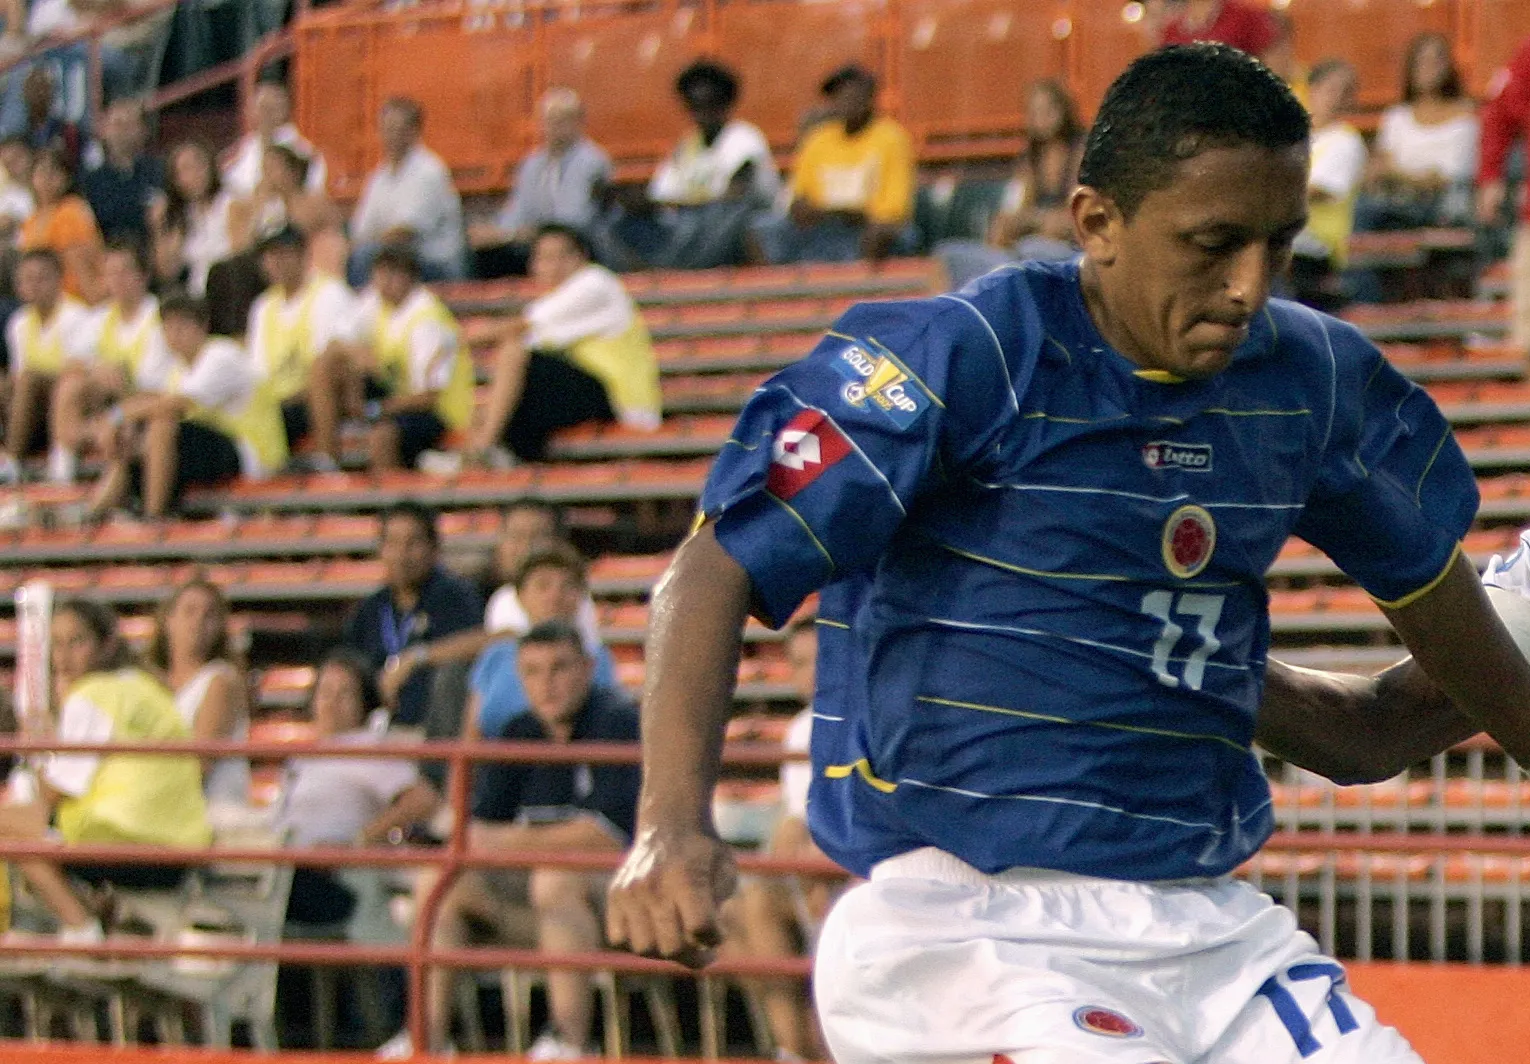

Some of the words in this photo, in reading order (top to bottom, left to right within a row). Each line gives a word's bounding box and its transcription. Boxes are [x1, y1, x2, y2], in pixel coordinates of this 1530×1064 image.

[843, 346, 875, 376] GOLD
[886, 385, 917, 412] CUP
[1140, 589, 1226, 691] 17
[1252, 962, 1361, 1059] 17
